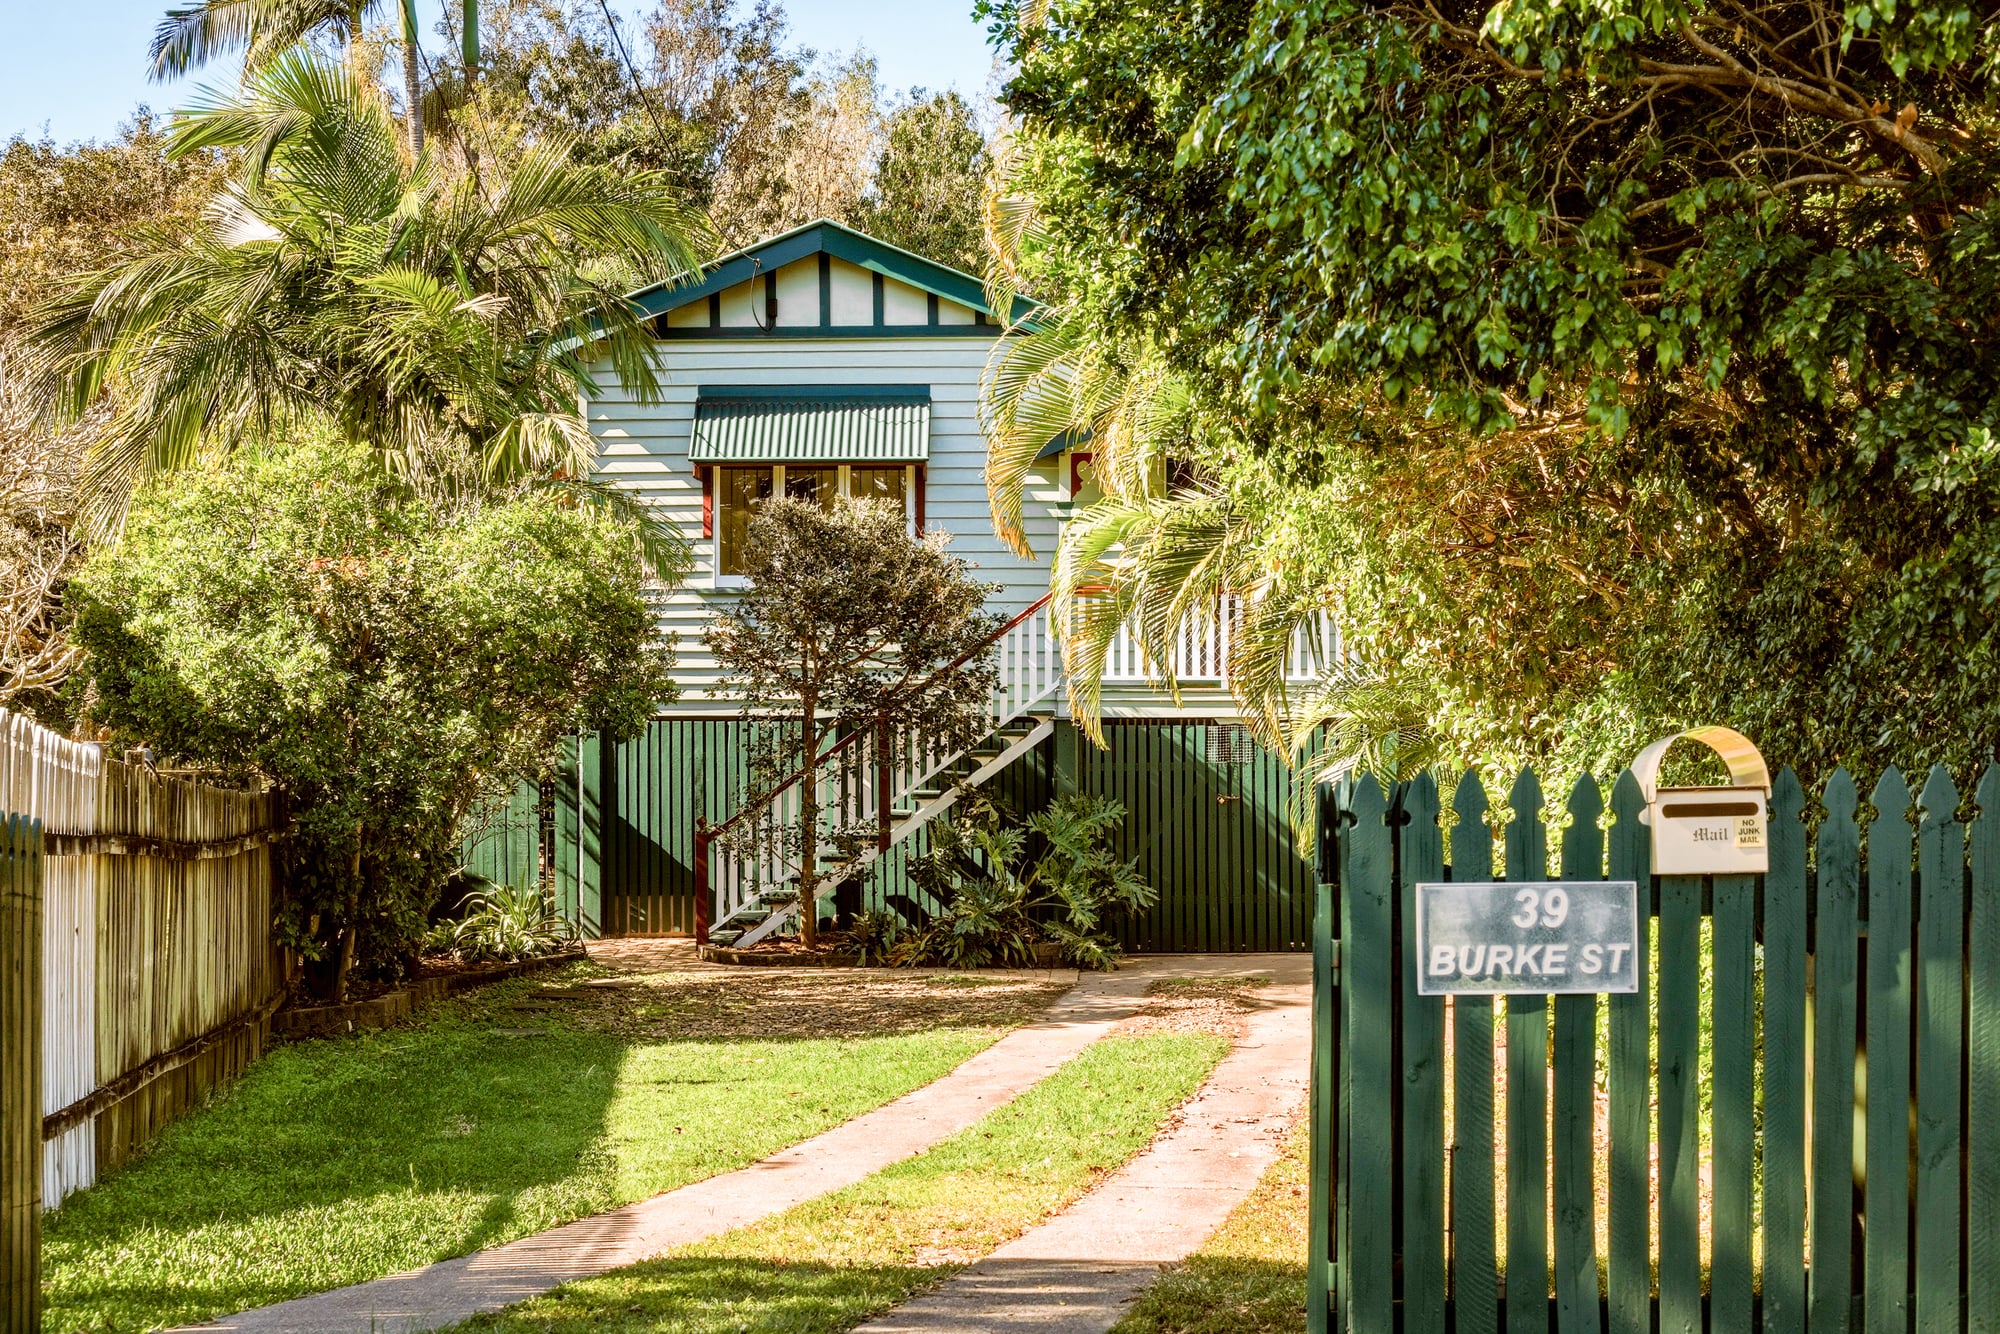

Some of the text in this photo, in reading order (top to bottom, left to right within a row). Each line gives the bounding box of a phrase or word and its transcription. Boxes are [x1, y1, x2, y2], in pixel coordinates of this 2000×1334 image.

[1692, 827, 1728, 841] Mail
[1738, 827, 1760, 835] JUNK
[1512, 888, 1569, 928] 39
[1428, 943, 1630, 976] BURKE ST
